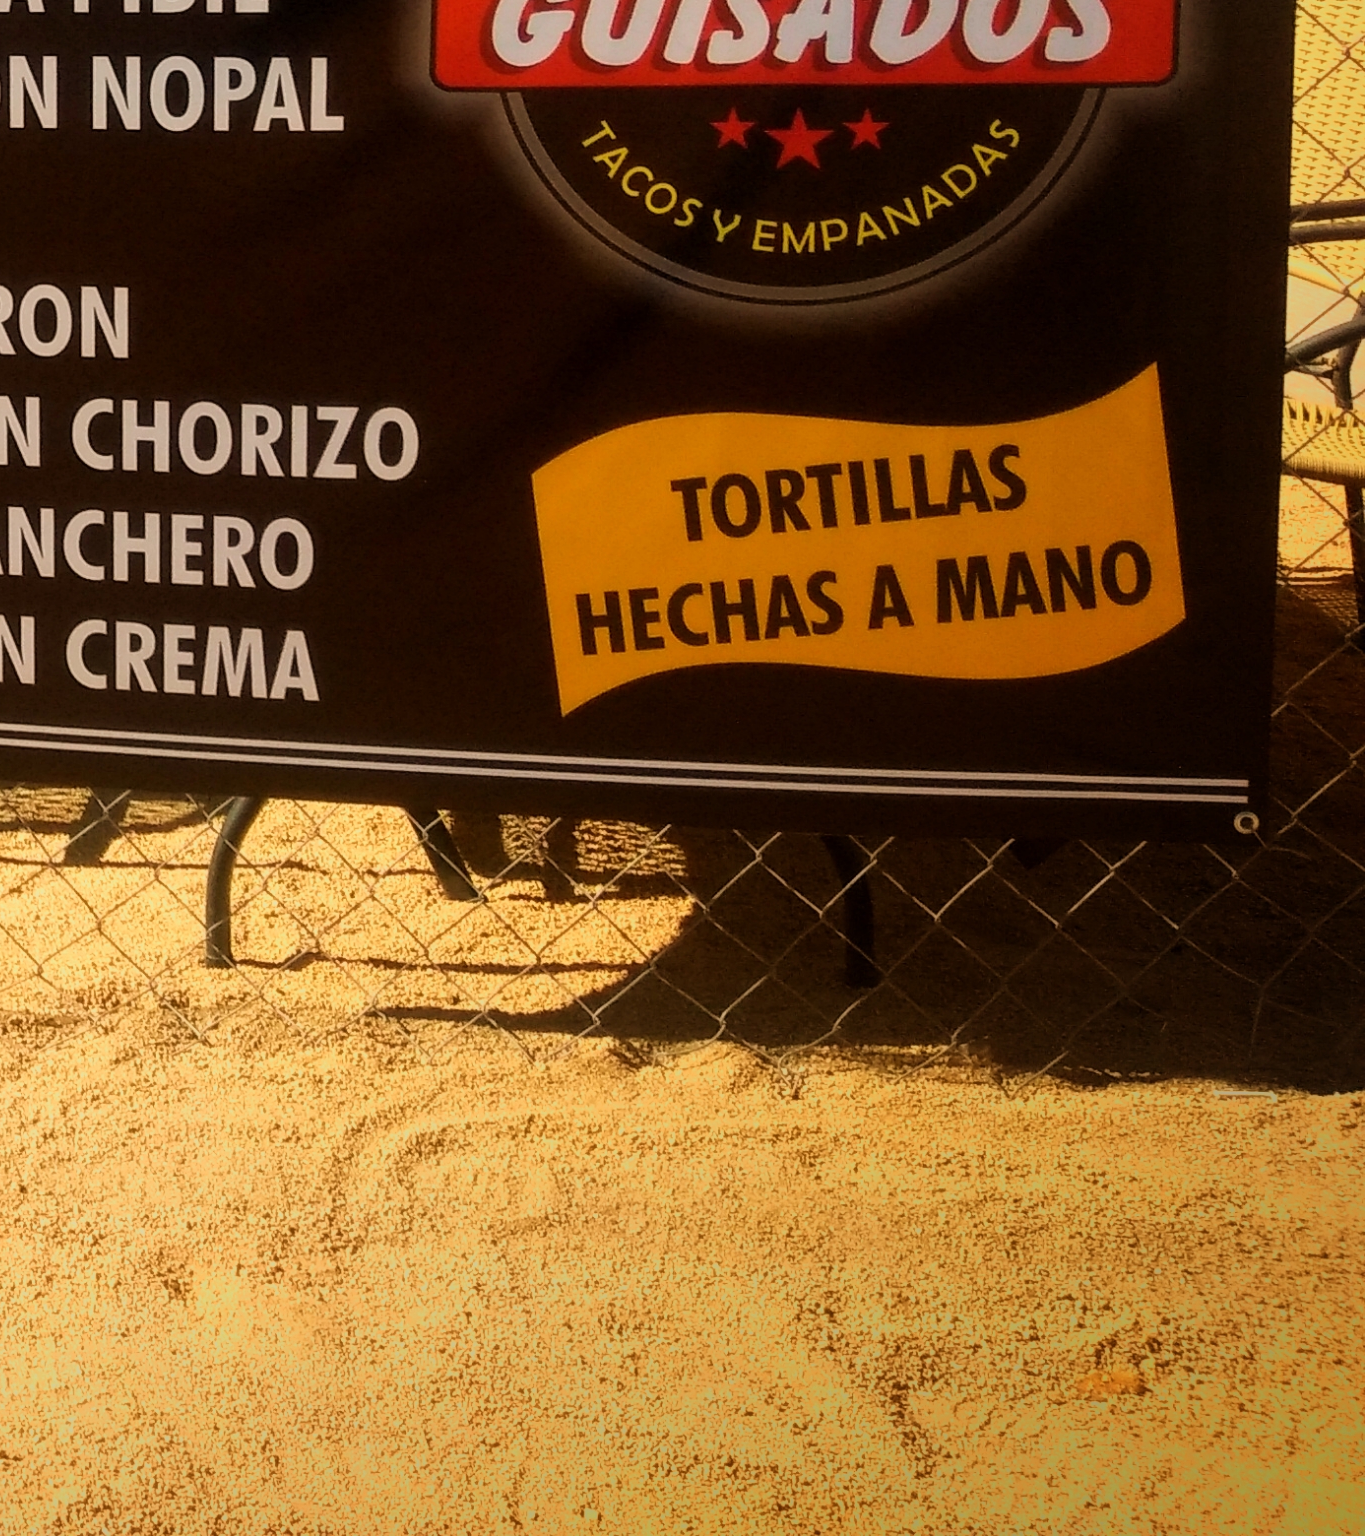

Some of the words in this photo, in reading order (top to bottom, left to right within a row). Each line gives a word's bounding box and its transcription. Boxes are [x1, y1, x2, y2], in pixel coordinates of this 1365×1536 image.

[93, 56, 344, 131] NOPAL
[582, 120, 702, 226] TACOS
[713, 209, 741, 242] Y
[752, 119, 1019, 253] EMPANADAS
[72, 399, 418, 480] CHORIZO
[671, 444, 1027, 541] TORTILLAS
[576, 571, 843, 655] HECHAS
[869, 565, 914, 629] A
[937, 540, 1152, 623] MANO
[66, 620, 319, 701] CREMA
